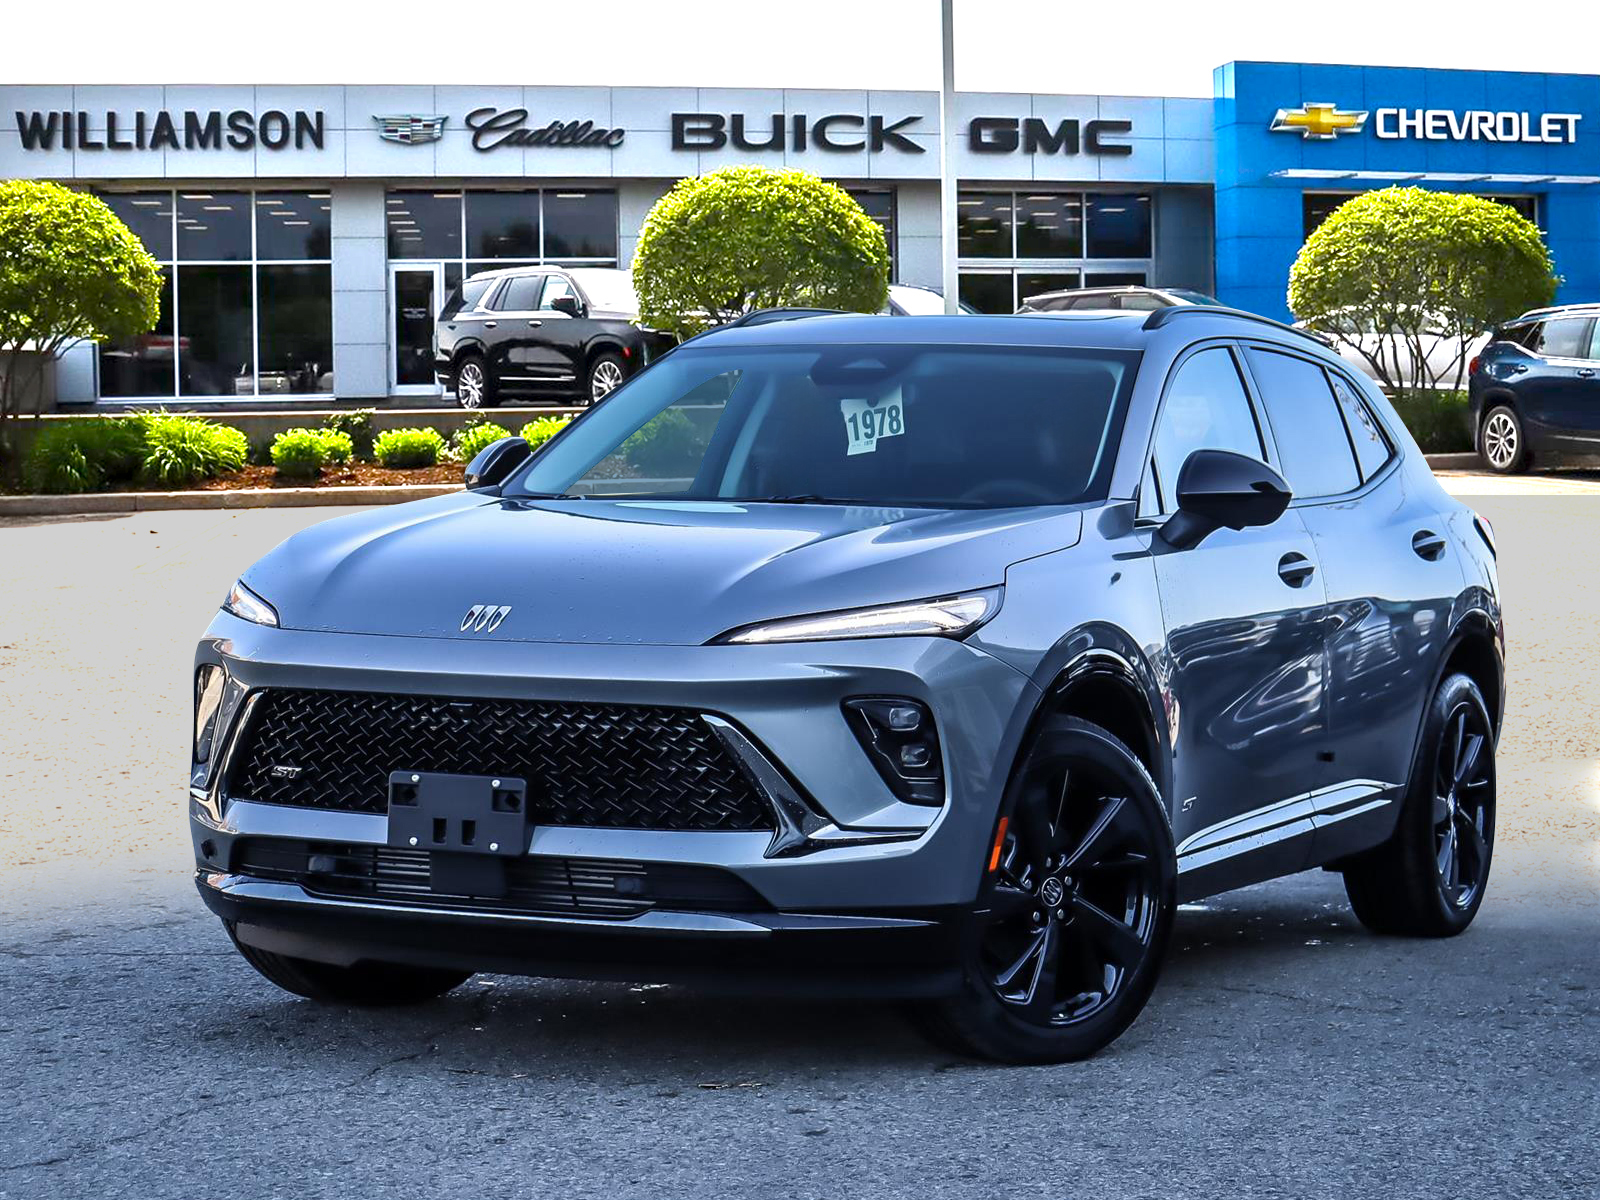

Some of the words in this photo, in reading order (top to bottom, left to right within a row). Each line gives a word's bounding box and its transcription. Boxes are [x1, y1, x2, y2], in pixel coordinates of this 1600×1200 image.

[16, 110, 324, 151] WILLIAMSON
[465, 107, 625, 153] Cadillac
[671, 113, 926, 154] BUICK
[969, 117, 1133, 156] GMC
[1376, 108, 1582, 143] CHEVROLET
[848, 404, 902, 441] 1978
[271, 765, 302, 779] ST
